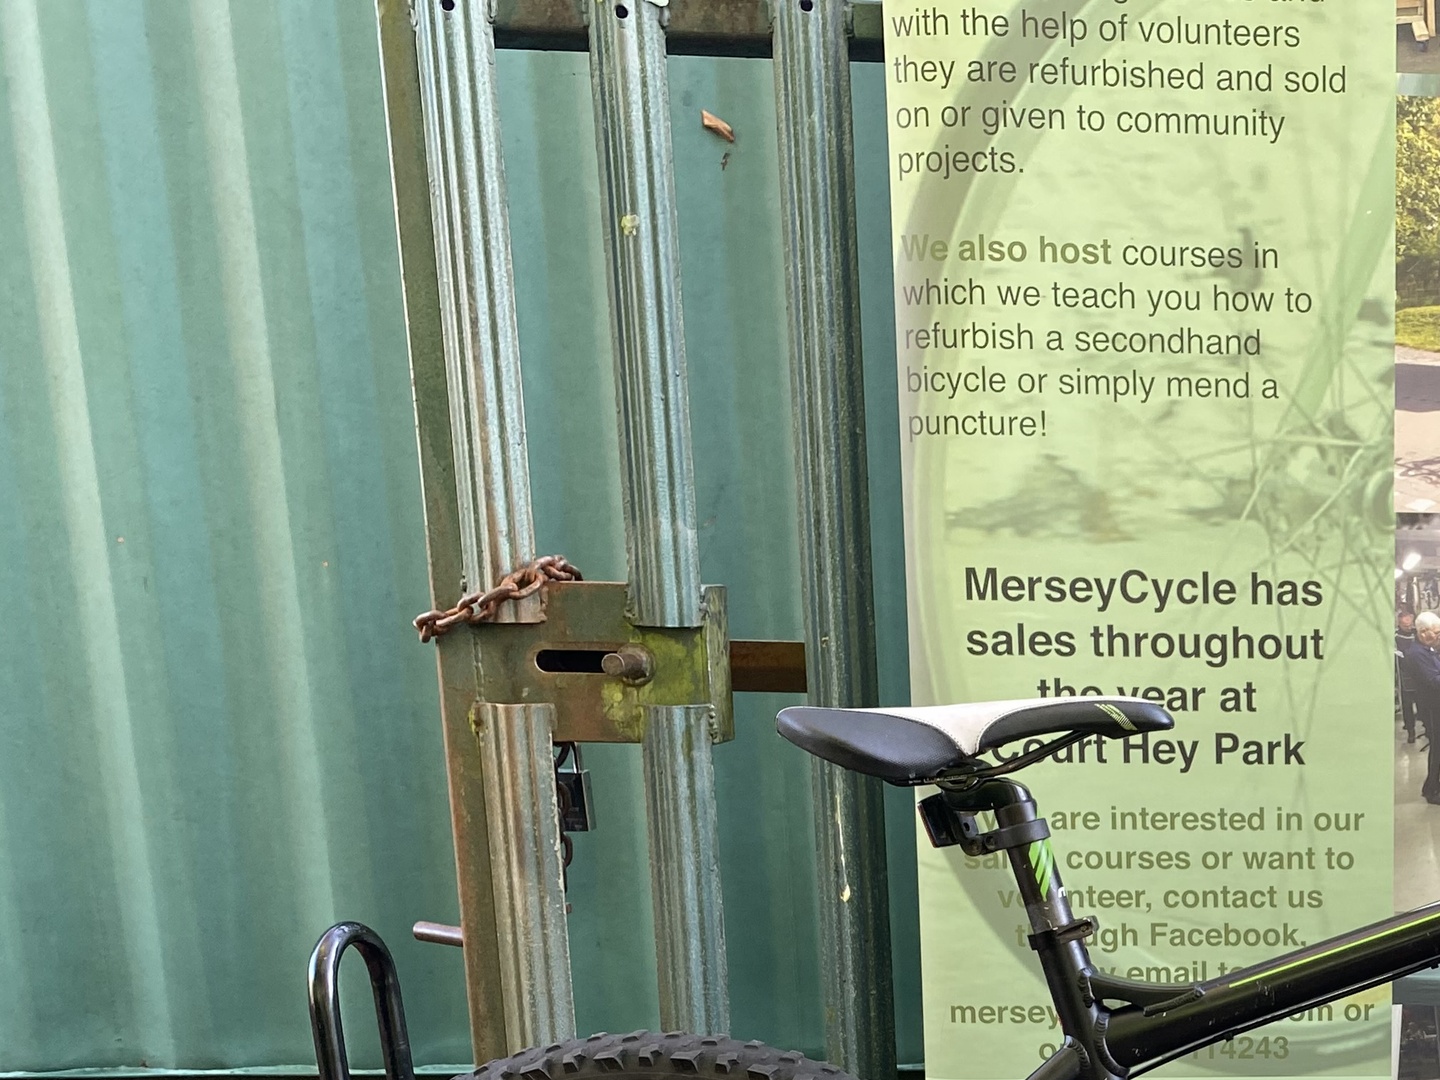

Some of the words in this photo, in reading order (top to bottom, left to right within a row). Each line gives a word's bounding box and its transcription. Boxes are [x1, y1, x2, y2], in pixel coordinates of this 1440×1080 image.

[893, 8, 949, 37] with
[960, 9, 1009, 37] the
[1022, 10, 1088, 46] help
[1100, 14, 1128, 42] of
[1138, 16, 1300, 48] volunteers
[894, 56, 955, 89] they
[967, 60, 1017, 83] are
[1029, 58, 1204, 90] refurbished
[1216, 64, 1272, 92] and
[1284, 65, 1346, 93] sold
[897, 105, 929, 128] on
[941, 104, 971, 128] or
[982, 103, 1066, 134] given
[1077, 105, 1105, 131] to
[1116, 110, 1285, 143] community
[899, 146, 1024, 181] projects.
[901, 235, 948, 260] We
[958, 234, 1027, 263] also
[1040, 237, 1112, 265] host
[1122, 243, 1243, 269] courses
[1254, 242, 1279, 269] in
[903, 279, 986, 307] which
[997, 285, 1041, 307] we
[1052, 282, 1136, 310] teach
[1147, 289, 1200, 317] you
[1213, 285, 1274, 313] how
[1285, 288, 1312, 313] to
[905, 323, 1033, 351] refurbish
[1046, 329, 1064, 352] a
[1075, 329, 1260, 356] secondhand
[907, 366, 1006, 399] bicycle
[1017, 371, 1047, 395] or
[1059, 369, 1155, 403] simply
[1166, 372, 1250, 399] mend
[1261, 376, 1279, 399] a
[908, 411, 1047, 443] puncture!
[965, 566, 1238, 613] MerseyCycle
[1251, 572, 1324, 607] has
[966, 623, 1076, 657] sales
[1092, 624, 1325, 668] throughout
[1220, 682, 1257, 713] at
[1123, 733, 1199, 773] Hey
[1215, 733, 1306, 766] Park
[1051, 809, 1101, 831] are
[1110, 805, 1265, 833] interested
[1277, 807, 1302, 832] in
[1314, 811, 1365, 832] our
[1066, 848, 1191, 871] courses
[1202, 849, 1234, 870] or
[1244, 847, 1315, 870] want
[1326, 847, 1356, 871] to
[1164, 886, 1278, 909] contact
[1286, 889, 1324, 909] us
[1126, 961, 1207, 983] email
[1344, 1003, 1375, 1021] or
